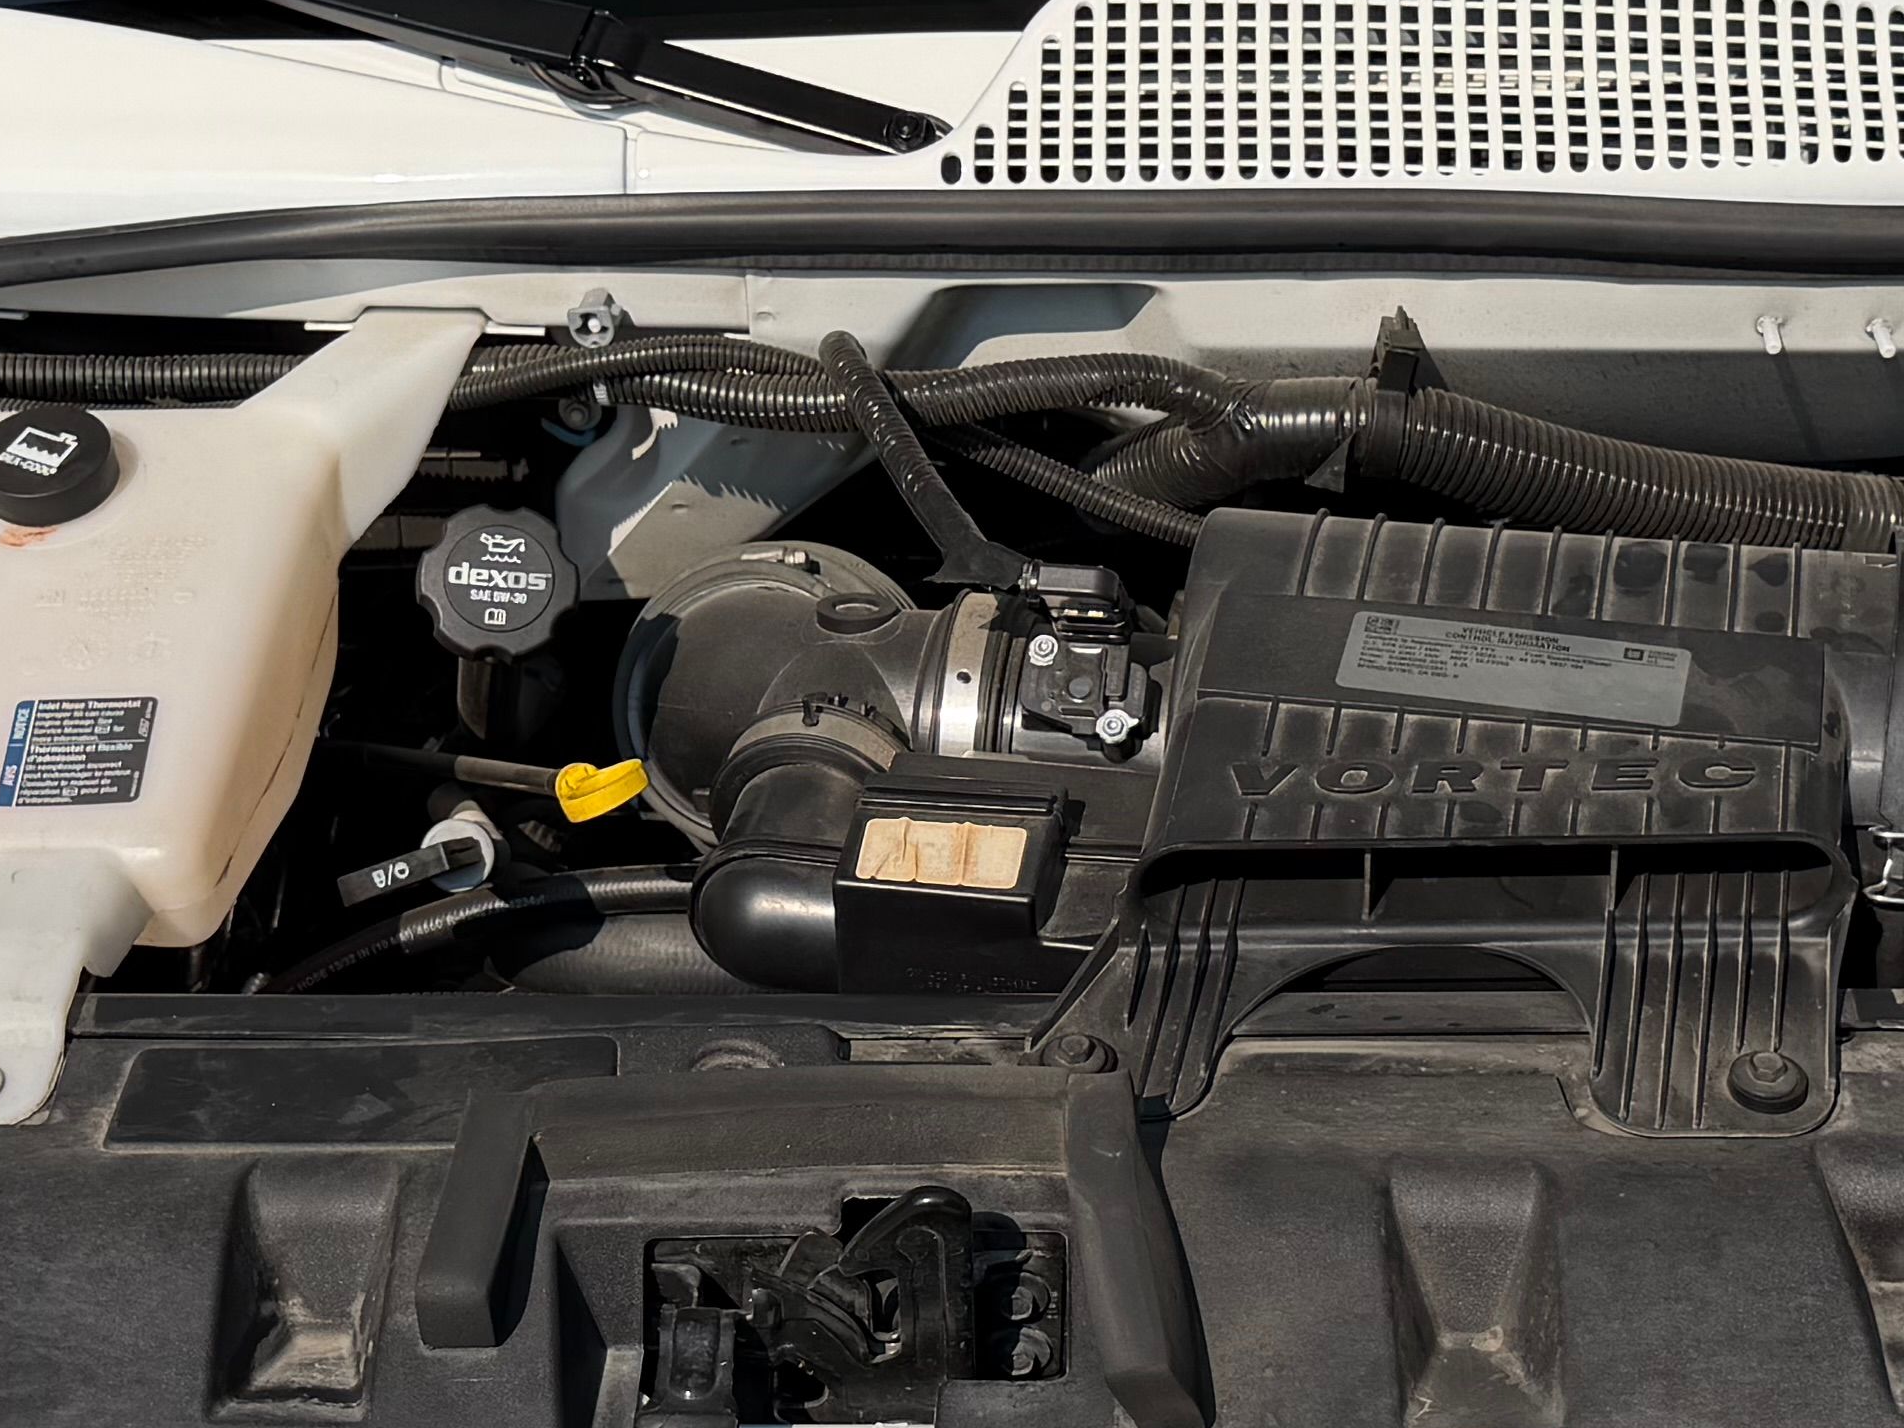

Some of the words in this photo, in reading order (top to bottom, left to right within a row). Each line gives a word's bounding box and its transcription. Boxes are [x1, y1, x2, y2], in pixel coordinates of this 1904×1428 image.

[448, 562, 548, 590] dexos
[470, 589, 491, 601] SAE
[1231, 758, 1756, 797] VORTEC
